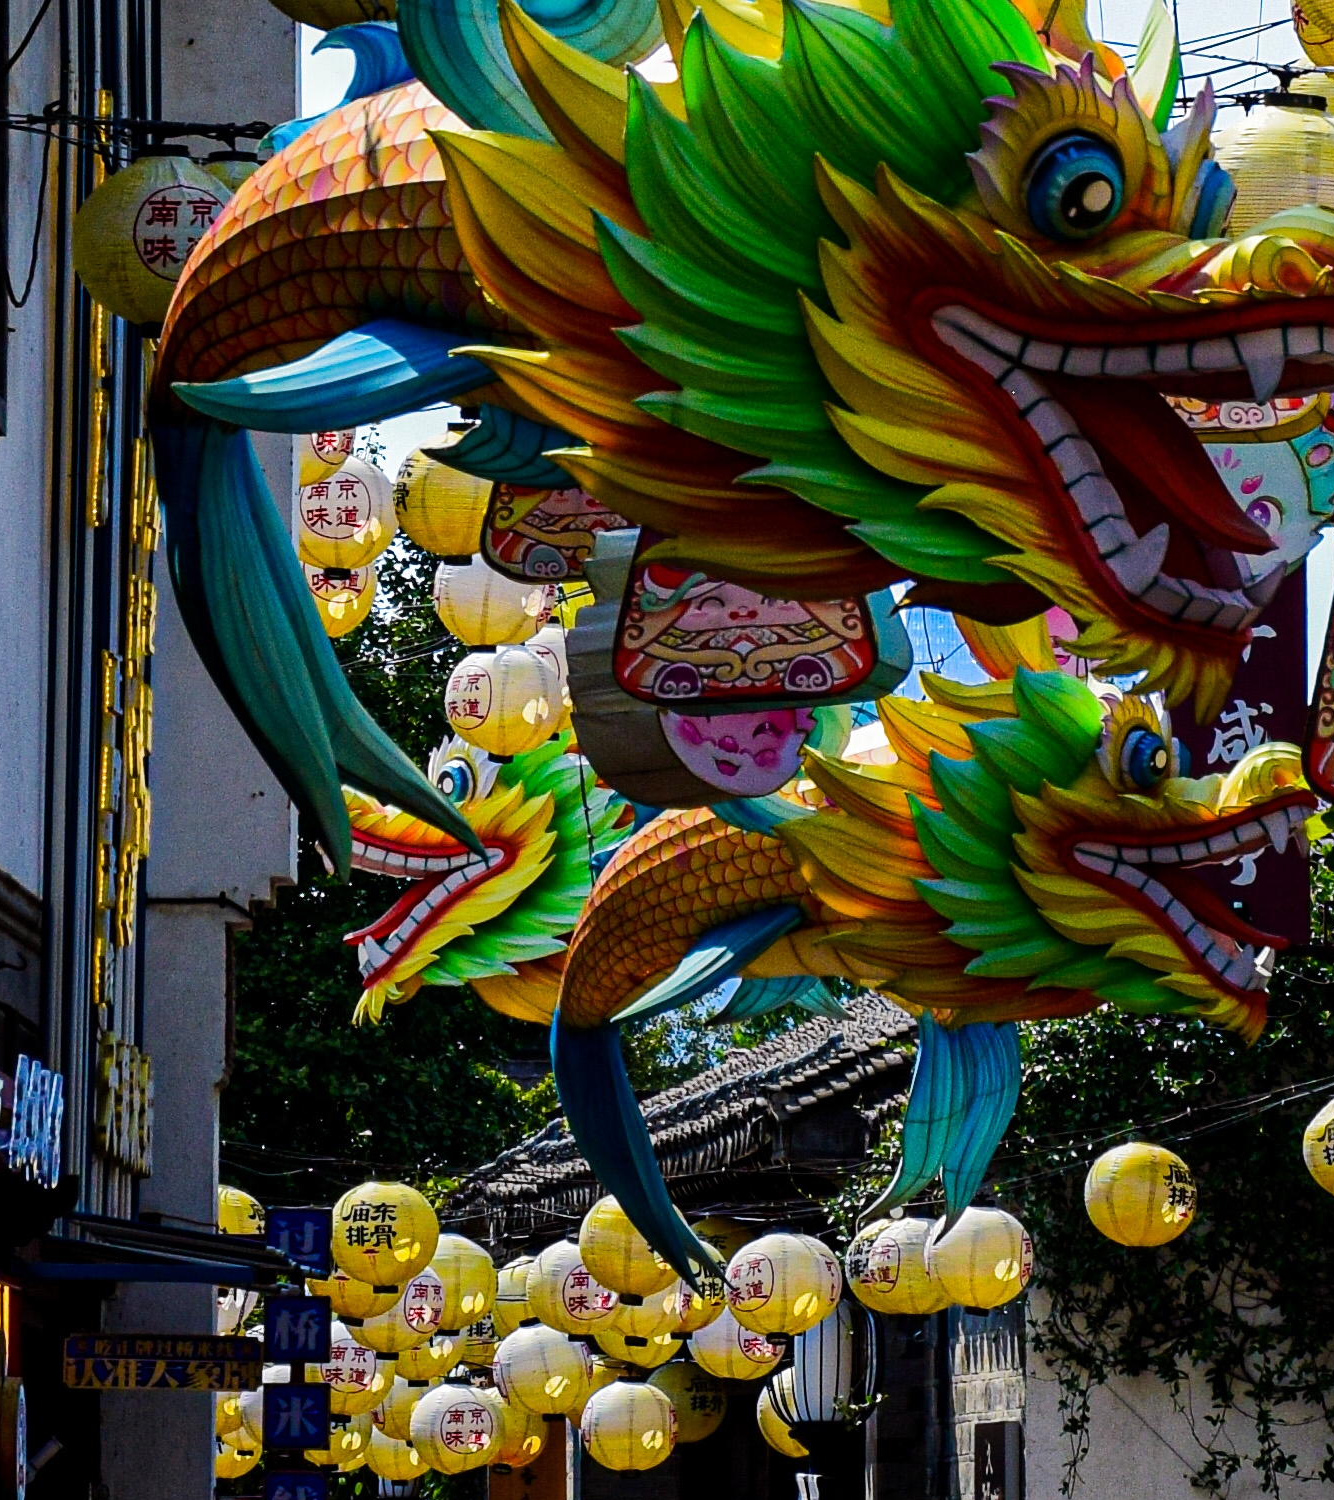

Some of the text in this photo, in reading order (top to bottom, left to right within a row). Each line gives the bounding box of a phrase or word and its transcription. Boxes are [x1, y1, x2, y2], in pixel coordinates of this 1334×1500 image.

[145, 198, 219, 228] 南京
[306, 478, 359, 501] 南京
[306, 505, 360, 530] 味道
[342, 1201, 397, 1223] 庙东
[345, 1225, 397, 1249] 排骨
[412, 1281, 442, 1302] 南京
[568, 1295, 614, 1313] 味道
[331, 1345, 370, 1363] 南京
[325, 1367, 370, 1387] 味道
[447, 1408, 485, 1425] 南京
[445, 1430, 487, 1447] 味道
